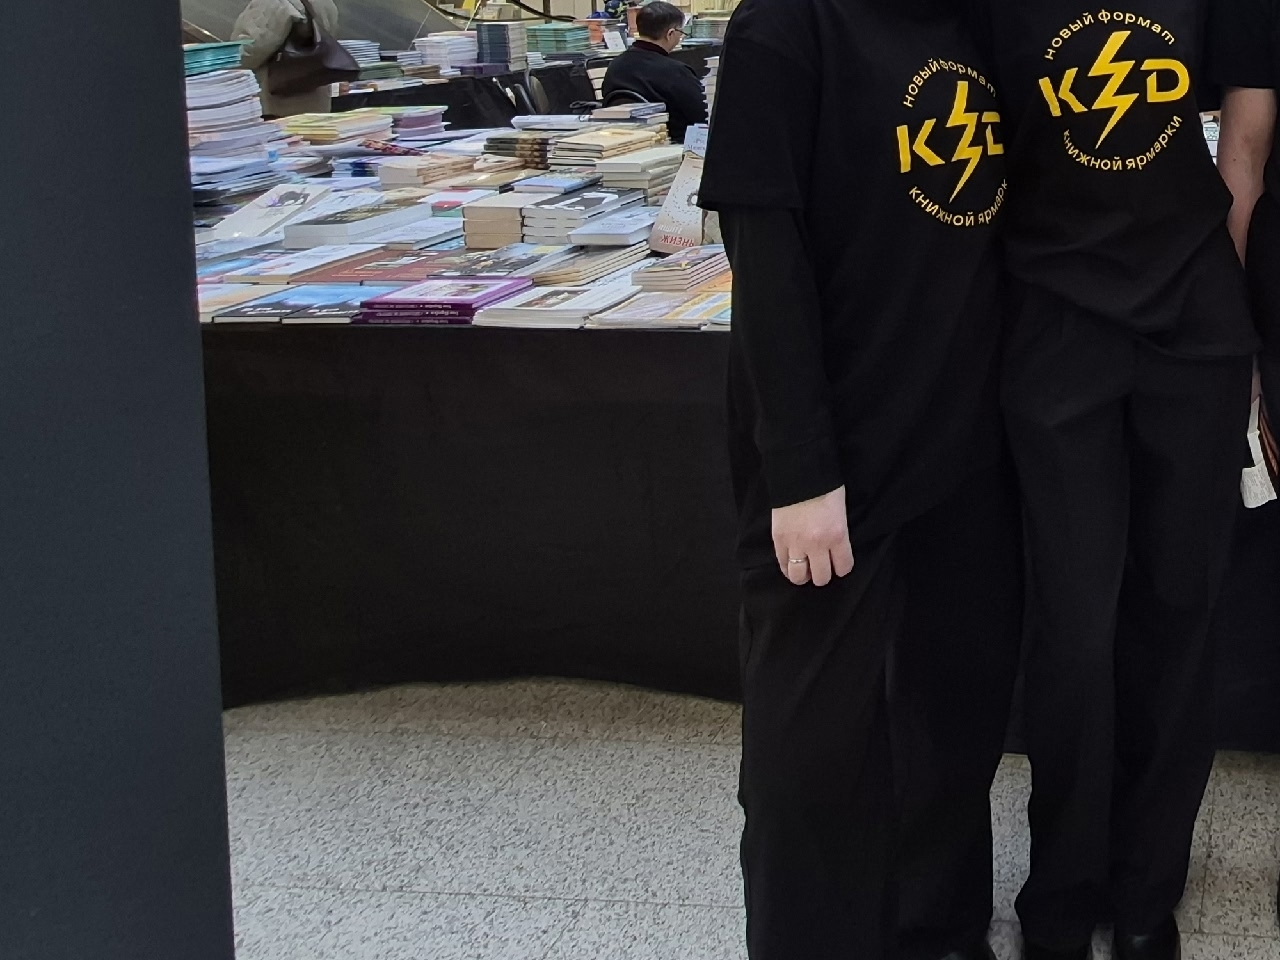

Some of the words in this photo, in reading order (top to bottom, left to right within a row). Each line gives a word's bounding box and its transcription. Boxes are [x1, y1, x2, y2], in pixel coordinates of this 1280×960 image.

[1044, 12, 1095, 60] новый
[1097, 9, 1175, 46] формат
[903, 58, 940, 108] новый
[939, 58, 996, 97] формат
[1063, 129, 1122, 171] книжной
[1126, 115, 1182, 171] ярмарки
[909, 186, 975, 226] книжной
[978, 178, 1008, 225] ярмарк
[661, 234, 695, 247] ЖИЗНЬ
